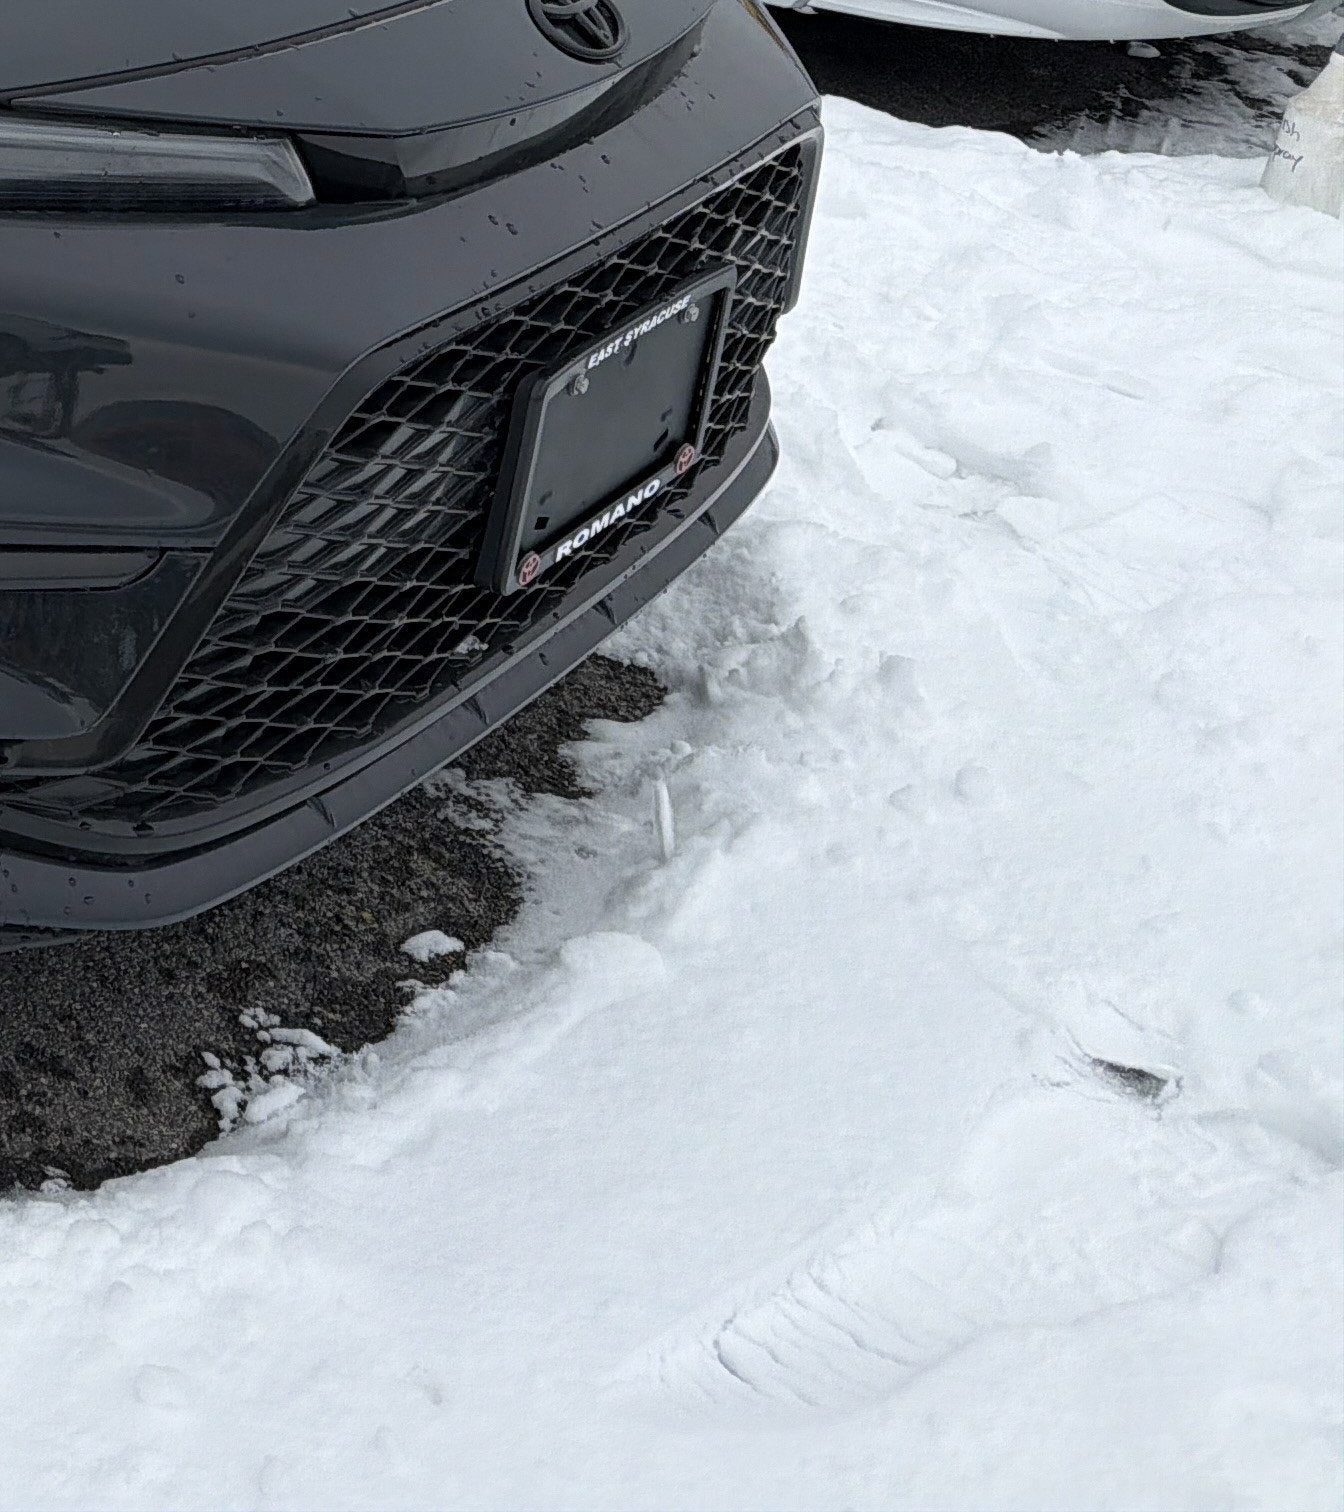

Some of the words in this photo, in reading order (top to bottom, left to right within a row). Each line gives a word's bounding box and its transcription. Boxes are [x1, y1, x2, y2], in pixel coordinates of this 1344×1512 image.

[587, 341, 622, 369] EAST
[623, 293, 693, 348] SYRACUSE
[555, 478, 662, 563] ROMANO
